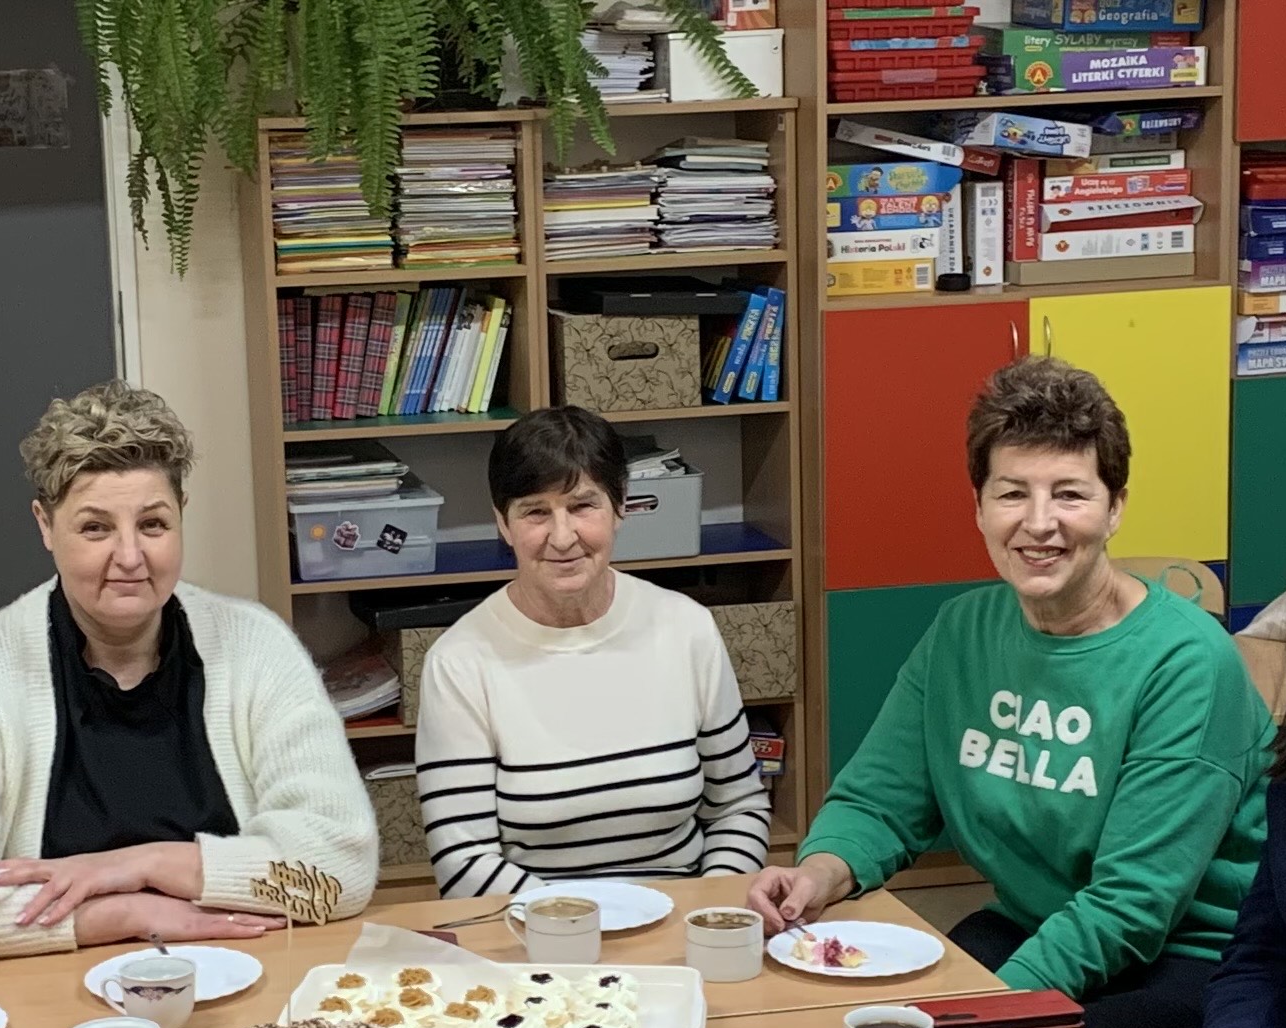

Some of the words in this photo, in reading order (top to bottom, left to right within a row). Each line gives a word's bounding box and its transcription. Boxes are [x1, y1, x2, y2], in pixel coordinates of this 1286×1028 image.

[1098, 9, 1158, 25] Geografia
[1024, 35, 1051, 47] litery
[1055, 34, 1102, 46] SYLABY
[1089, 55, 1148, 71] MOZAIKA
[1072, 70, 1114, 83] LITERKI
[1117, 67, 1165, 79] CYFERKI
[1261, 275, 1286, 287] MAPA
[1248, 357, 1273, 370] MAPA
[990, 690, 1092, 745] CIAO
[959, 728, 1098, 797] BELLA
